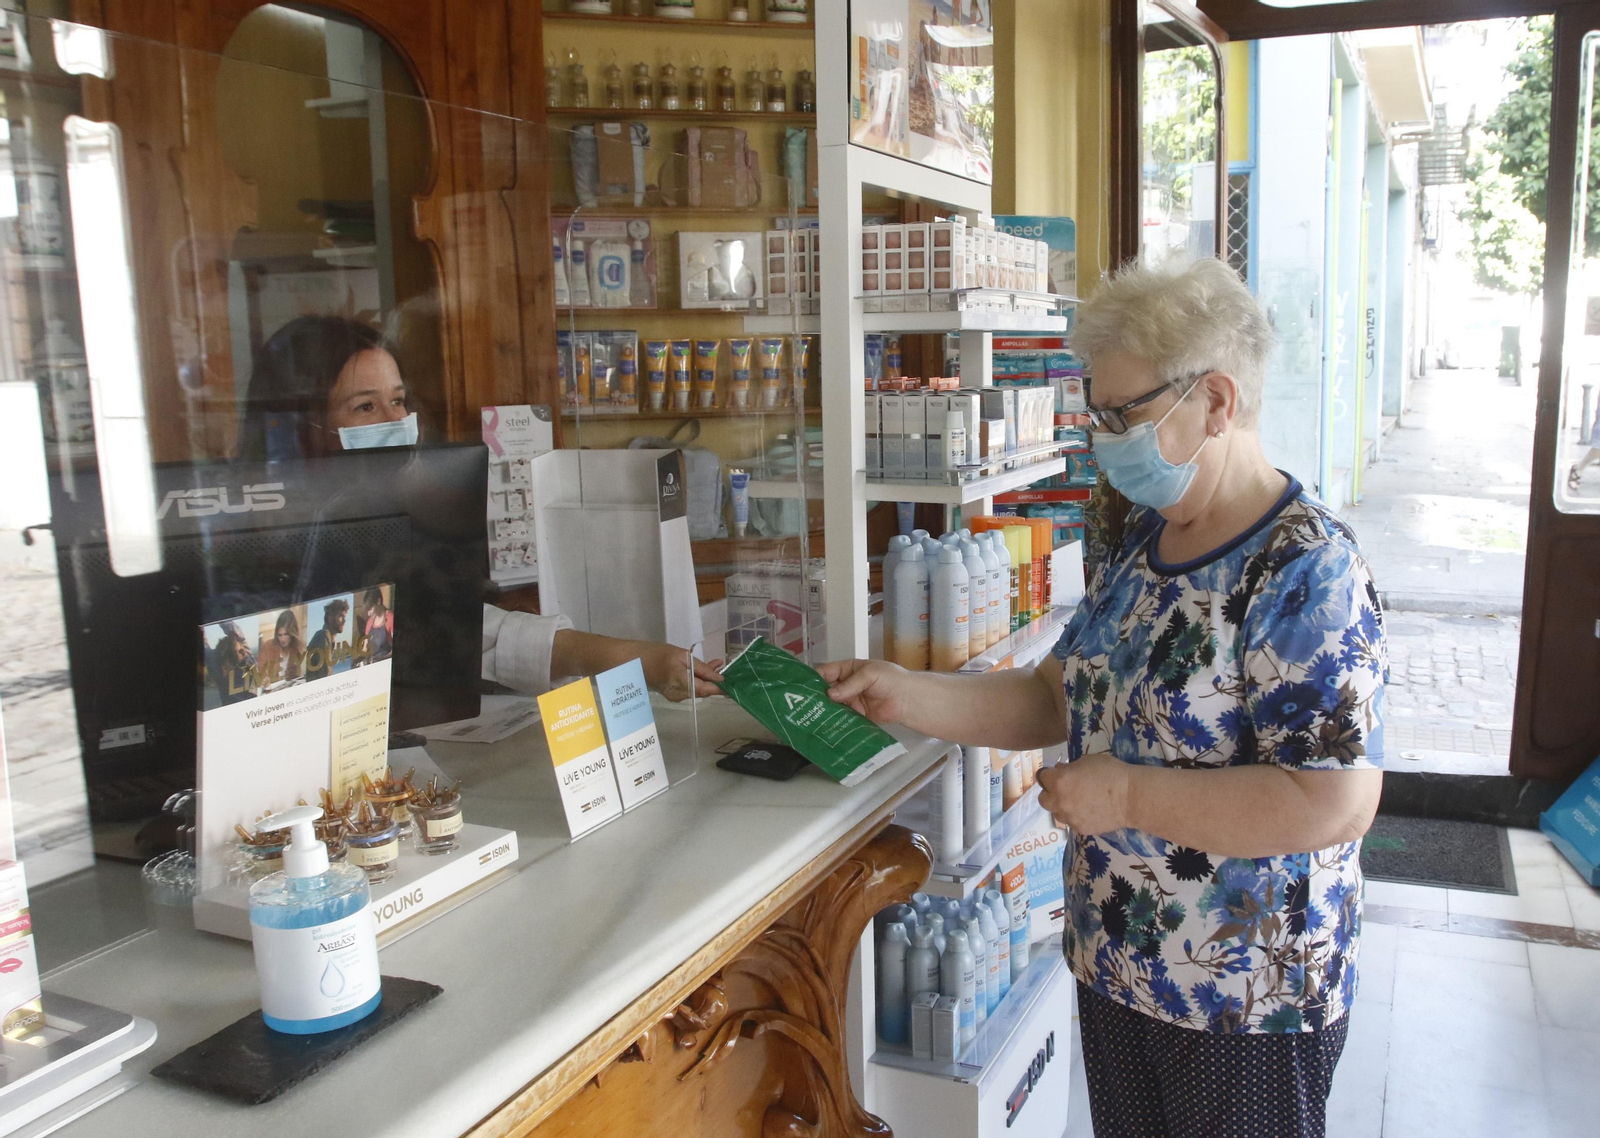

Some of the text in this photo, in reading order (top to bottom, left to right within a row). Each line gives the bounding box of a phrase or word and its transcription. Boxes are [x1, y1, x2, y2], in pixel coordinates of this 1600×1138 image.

[505, 416, 530, 427] steel
[155, 482, 286, 520] ASUS
[727, 583, 771, 595] NAILINE
[737, 599, 761, 607] OXYGEN
[294, 634, 373, 672] YOUNG
[614, 682, 635, 696] RUTINA
[246, 707, 264, 719] Vivir
[265, 701, 285, 715] joven
[325, 686, 334, 696] de
[335, 679, 359, 694] actitud
[610, 688, 643, 708] HIDRATANTE
[250, 717, 271, 729] Verse
[272, 711, 293, 725] joven
[333, 694, 342, 704] de
[342, 691, 356, 704] piel
[558, 702, 582, 719] RUTINA
[796, 701, 824, 726] Andalucía
[810, 707, 826, 722] cuida
[550, 707, 595, 732] ANTIOXIDANTE
[633, 735, 656, 752] YOUNG
[579, 758, 607, 777] YOUNG
[642, 769, 656, 783] ISDIN
[591, 795, 606, 808] ISDIN
[1573, 808, 1598, 836] PEDICURE
[491, 843, 510, 858] ISDIN
[1006, 831, 1059, 859] REGALO
[366, 855, 390, 863] PEELING
[373, 888, 424, 924] YOUNG
[312, 927, 322, 935] gel
[317, 934, 356, 952] ARBASY
[331, 1004, 343, 1013] 500
[1027, 1030, 1054, 1093] ISDIN
